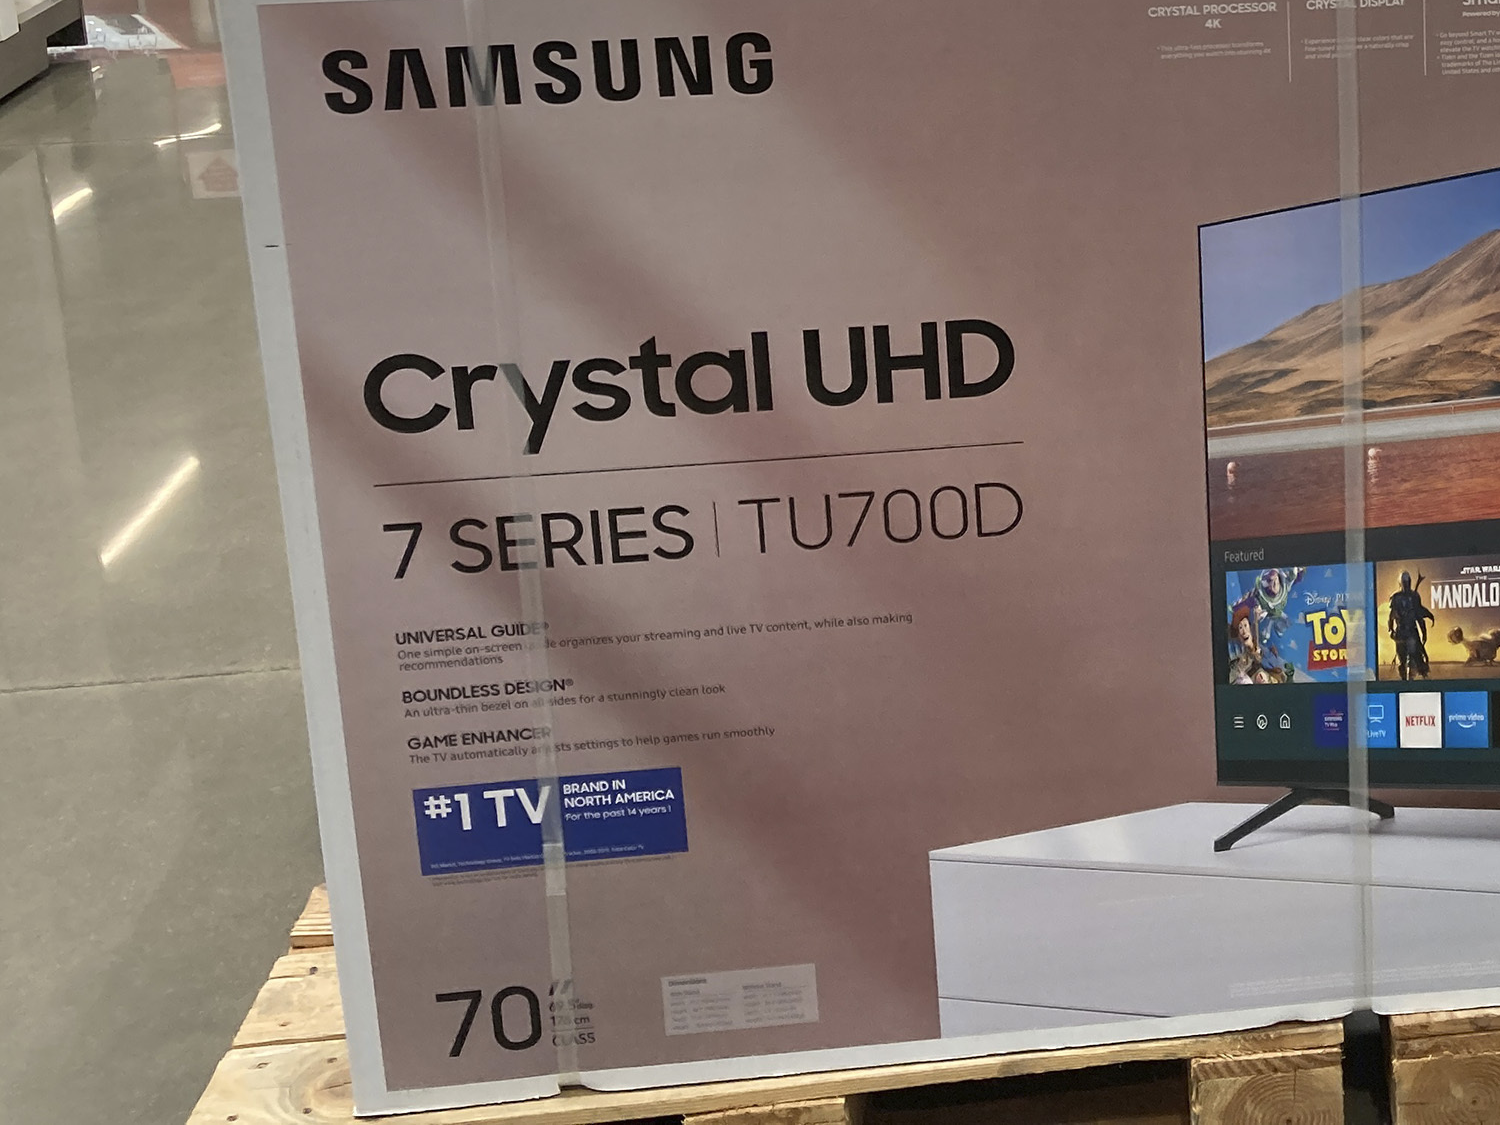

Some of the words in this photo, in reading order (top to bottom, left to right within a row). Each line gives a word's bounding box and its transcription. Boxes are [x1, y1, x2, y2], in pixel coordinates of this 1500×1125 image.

[1148, 5, 1201, 18] CRYSTAL
[1203, 2, 1277, 15] PROCESSOR
[321, 32, 774, 114] SAMSUNG
[363, 331, 774, 456] Crystal
[802, 318, 1016, 407] UHD
[382, 523, 424, 579] 7
[449, 504, 696, 574] SERIES
[738, 483, 1024, 553] TU700D
[1224, 547, 1265, 564] Featured
[395, 626, 487, 645] UNIVERSAL
[402, 684, 500, 704] BOUNDLESS
[1405, 714, 1436, 728] NETFLIX
[408, 734, 458, 750] GAME
[563, 781, 609, 795] BRAND
[612, 779, 626, 791] IN
[424, 793, 472, 831] #1
[483, 785, 551, 827] TV
[564, 794, 612, 809] NORTH
[615, 789, 675, 805] AMERICA
